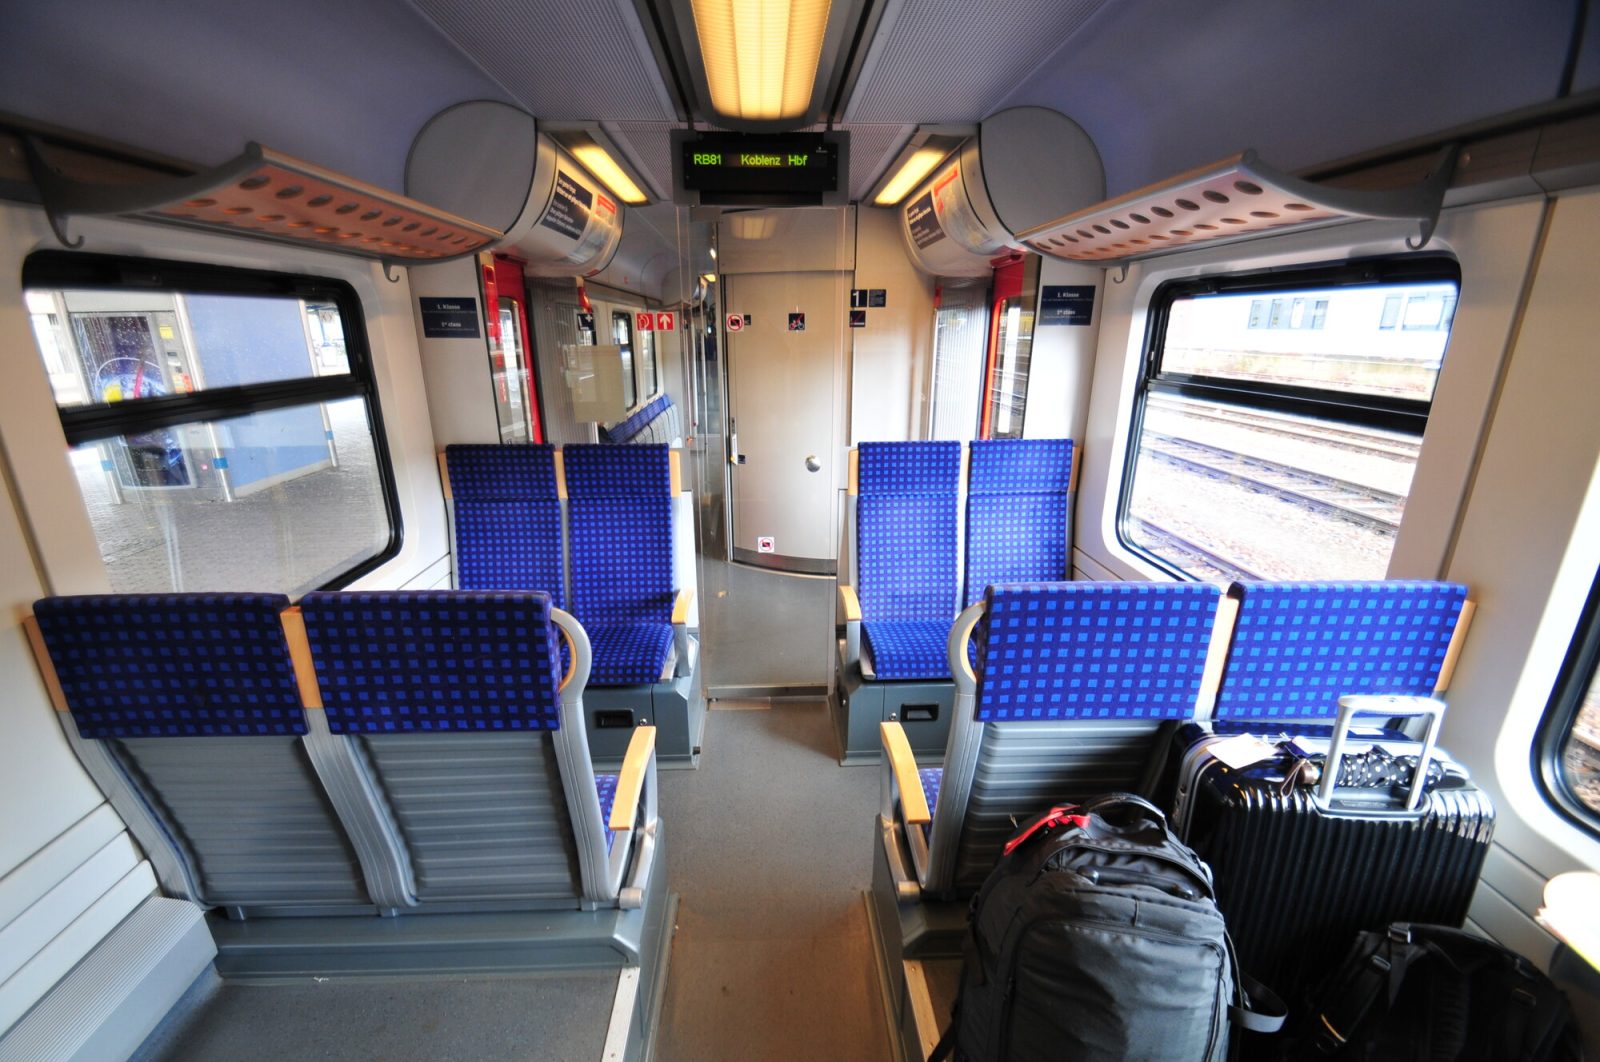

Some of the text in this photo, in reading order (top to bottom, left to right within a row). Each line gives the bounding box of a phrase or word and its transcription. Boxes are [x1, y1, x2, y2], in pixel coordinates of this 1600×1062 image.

[693, 154, 809, 166] RB81 Koblenz Hbf
[852, 291, 860, 307] 1
